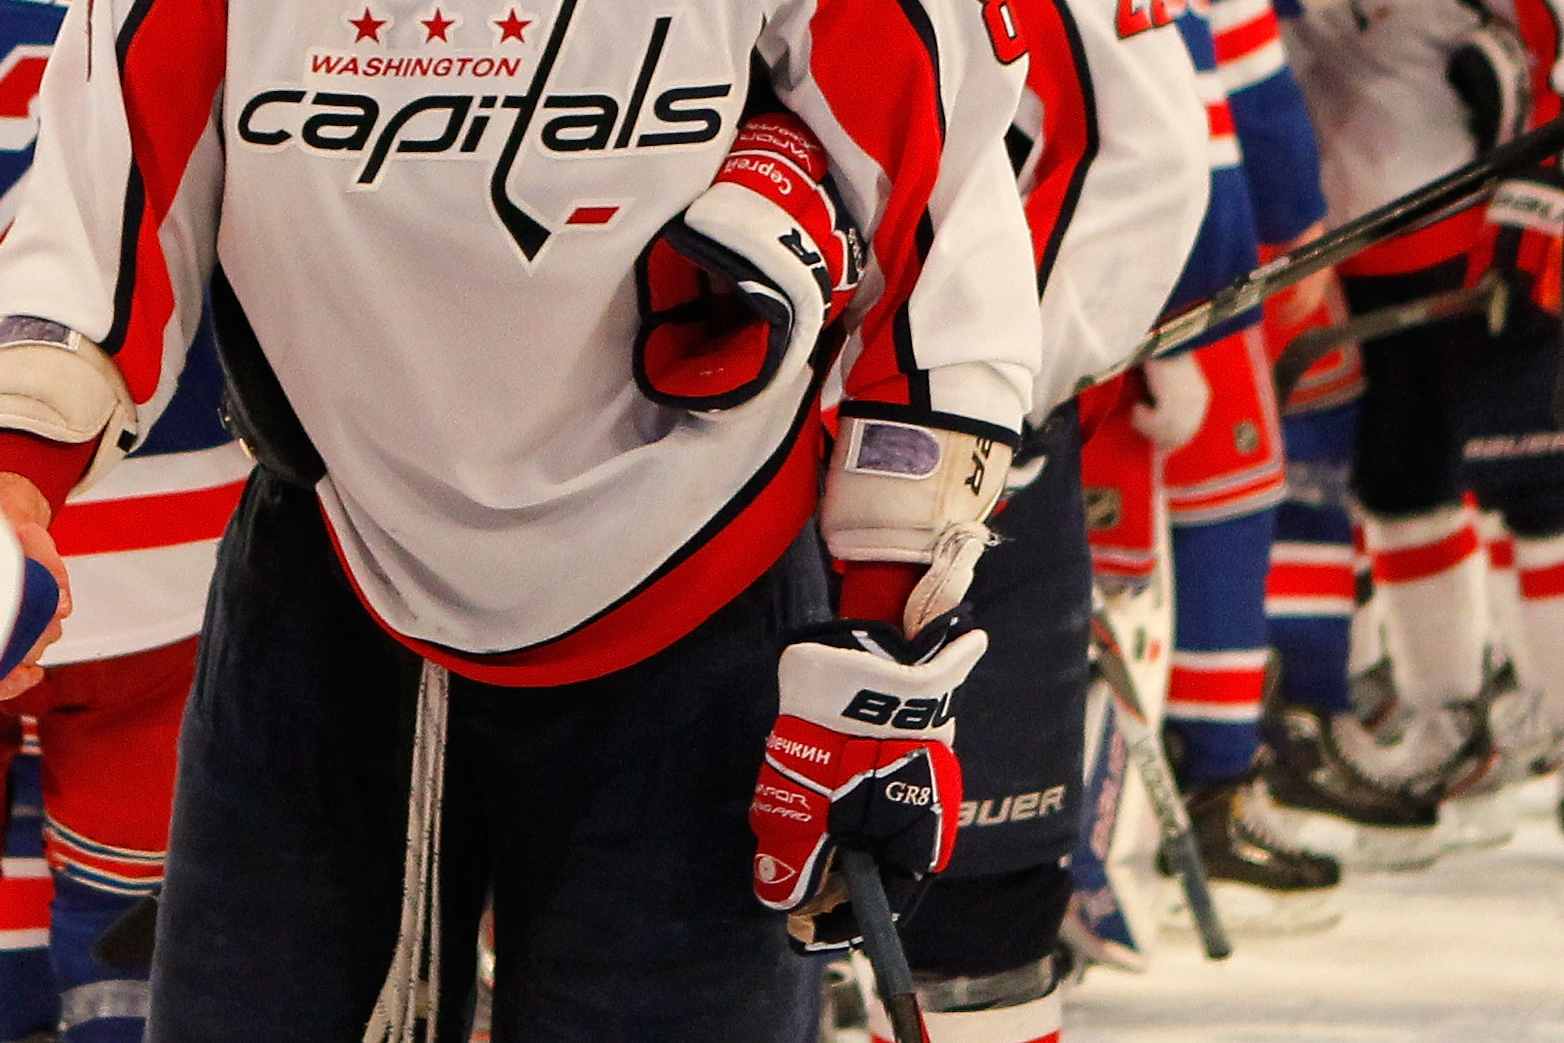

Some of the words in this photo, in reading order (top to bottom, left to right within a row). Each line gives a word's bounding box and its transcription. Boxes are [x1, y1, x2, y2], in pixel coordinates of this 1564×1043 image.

[311, 54, 522, 79] WASHINGTON
[885, 781, 932, 806] GR8
[956, 784, 1066, 828] AUER
